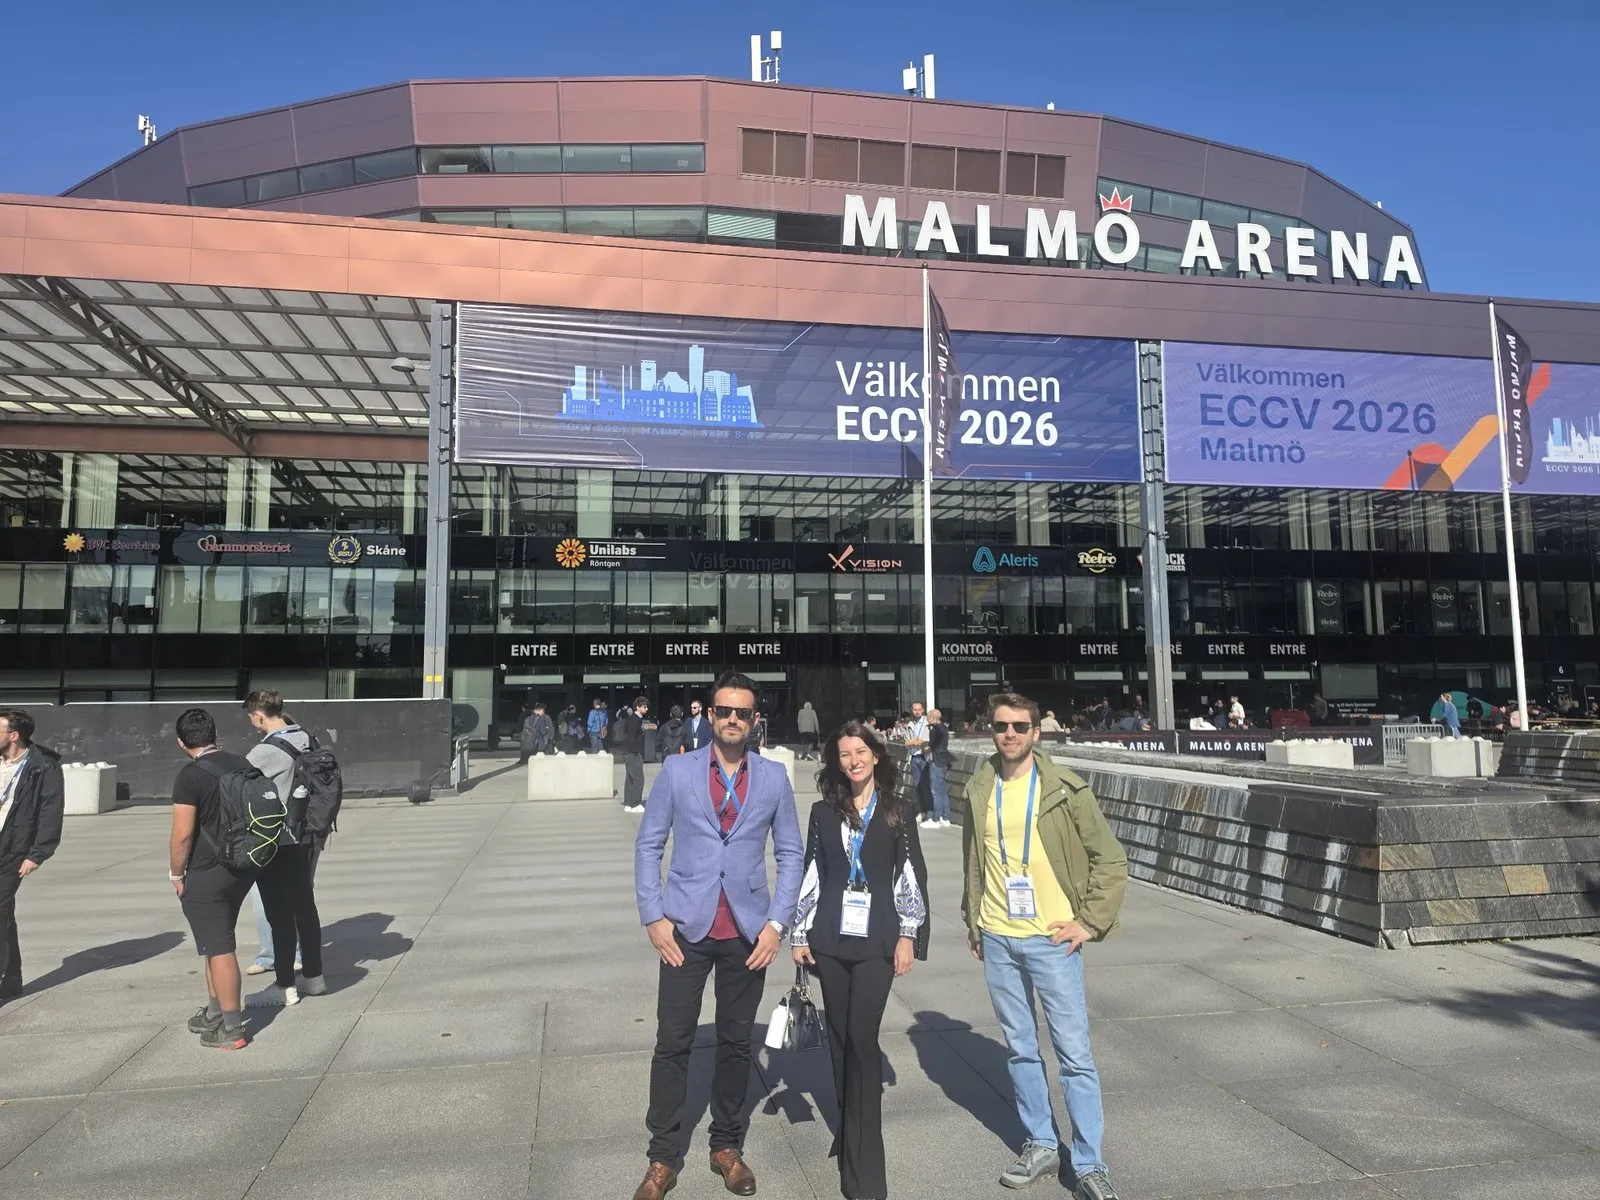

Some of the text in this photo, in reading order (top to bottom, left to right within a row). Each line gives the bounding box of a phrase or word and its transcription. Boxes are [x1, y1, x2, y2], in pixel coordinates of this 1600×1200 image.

[1181, 219, 1423, 284] ARENA
[836, 360, 1060, 403] Välkmmen
[1196, 362, 1345, 389] Välkommen
[1200, 393, 1437, 435] ECCV 2026
[959, 409, 1059, 447] 2026
[1200, 436, 1305, 464] Malmö
[1545, 464, 1594, 473] ECCV 2026
[366, 544, 407, 556] Skåne
[589, 544, 637, 555] Unilabs
[589, 560, 621, 568] Röntgen
[848, 559, 902, 568] VISION
[999, 553, 1039, 567] Aleris
[1078, 552, 1117, 565] Retro
[941, 643, 993, 655] KONTOR
[1558, 665, 1564, 674] 6
[1129, 741, 1166, 751] ARENA
[1236, 741, 1265, 751] AREN
